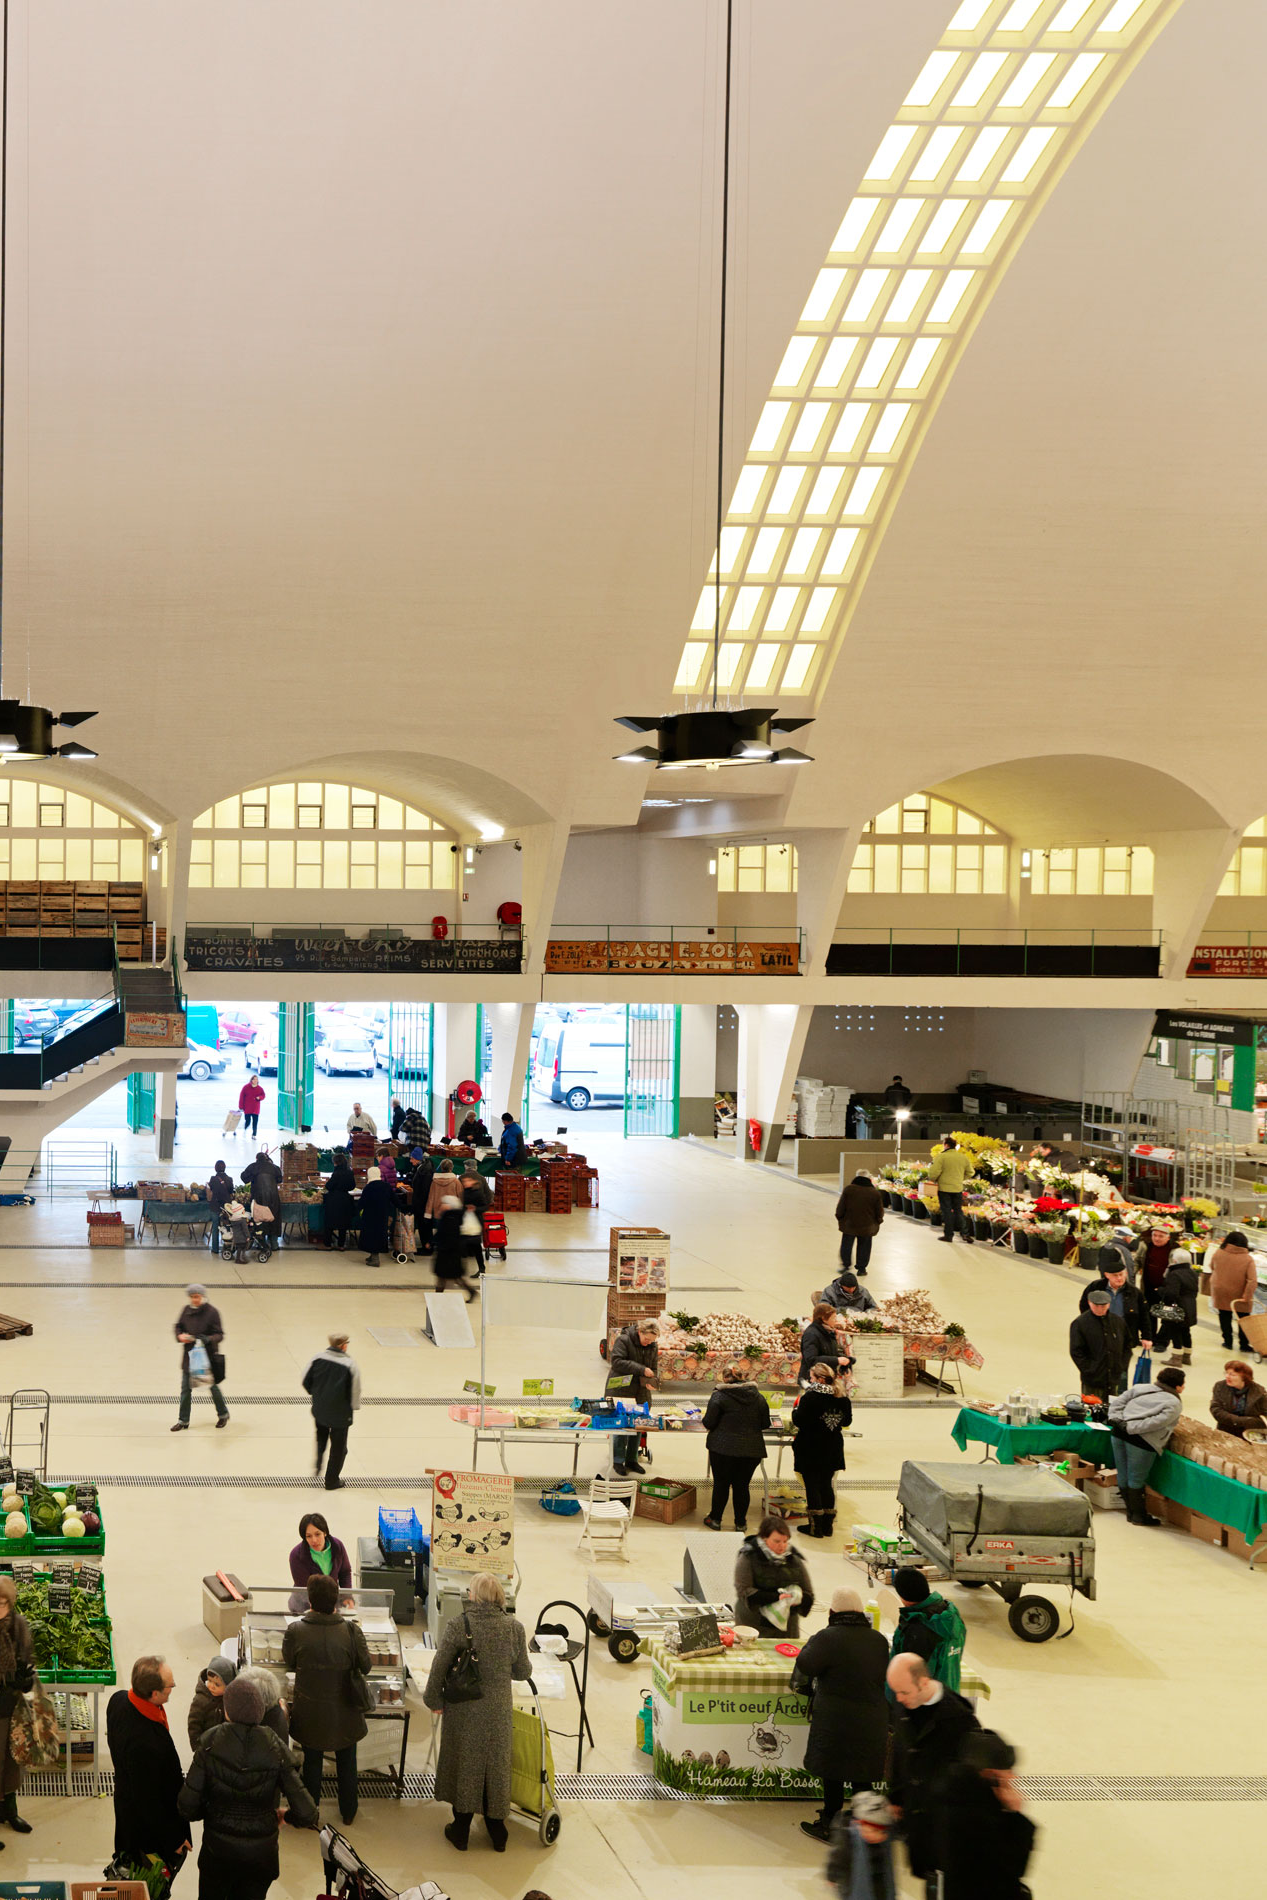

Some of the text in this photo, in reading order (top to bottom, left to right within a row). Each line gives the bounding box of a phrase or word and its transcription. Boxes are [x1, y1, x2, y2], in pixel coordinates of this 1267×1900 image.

[188, 946, 245, 956] TRICOTS
[456, 948, 516, 958] TORCHONS
[205, 958, 284, 967] CRAVATES
[376, 954, 412, 962] REIMS
[761, 954, 793, 966] LATIL
[421, 960, 494, 968] SERVIETTES
[1178, 1021, 1203, 1030] VOLAILLES
[1200, 1031, 1216, 1039] FERME
[456, 1474, 512, 1486] FROMAGERIE
[690, 1700, 705, 1713] Le
[709, 1700, 735, 1713] P'tit
[739, 1700, 771, 1713] oeuf
[688, 1770, 820, 1788] Hameau La Basse
